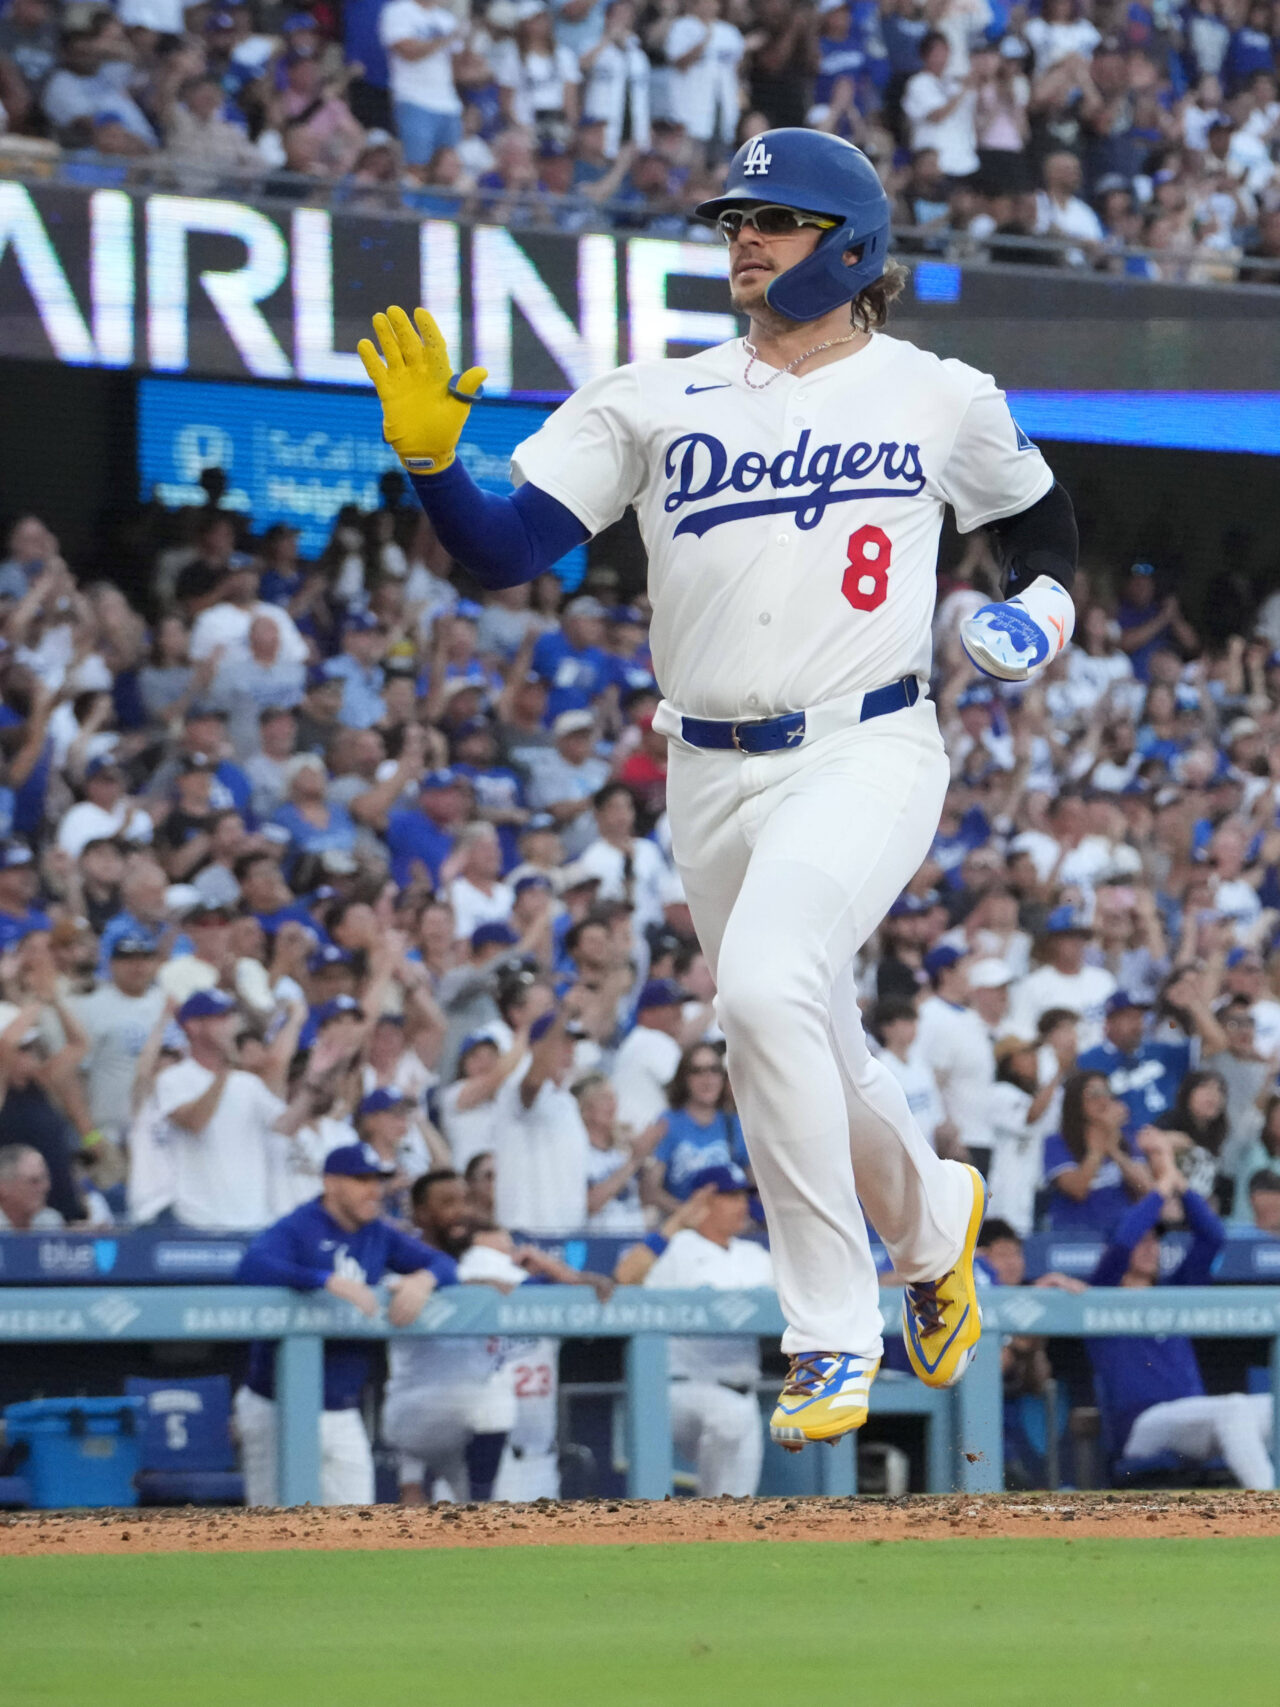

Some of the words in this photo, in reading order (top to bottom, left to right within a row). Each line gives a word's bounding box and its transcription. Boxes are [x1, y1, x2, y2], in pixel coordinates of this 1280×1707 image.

[743, 136, 772, 175] LA
[665, 428, 927, 535] Dodgers
[841, 524, 892, 612] 8
[1082, 1308, 1143, 1331] BANK
[1145, 1308, 1175, 1331] OF
[1177, 1308, 1274, 1331] AMERICA
[514, 1364, 551, 1398] 23
